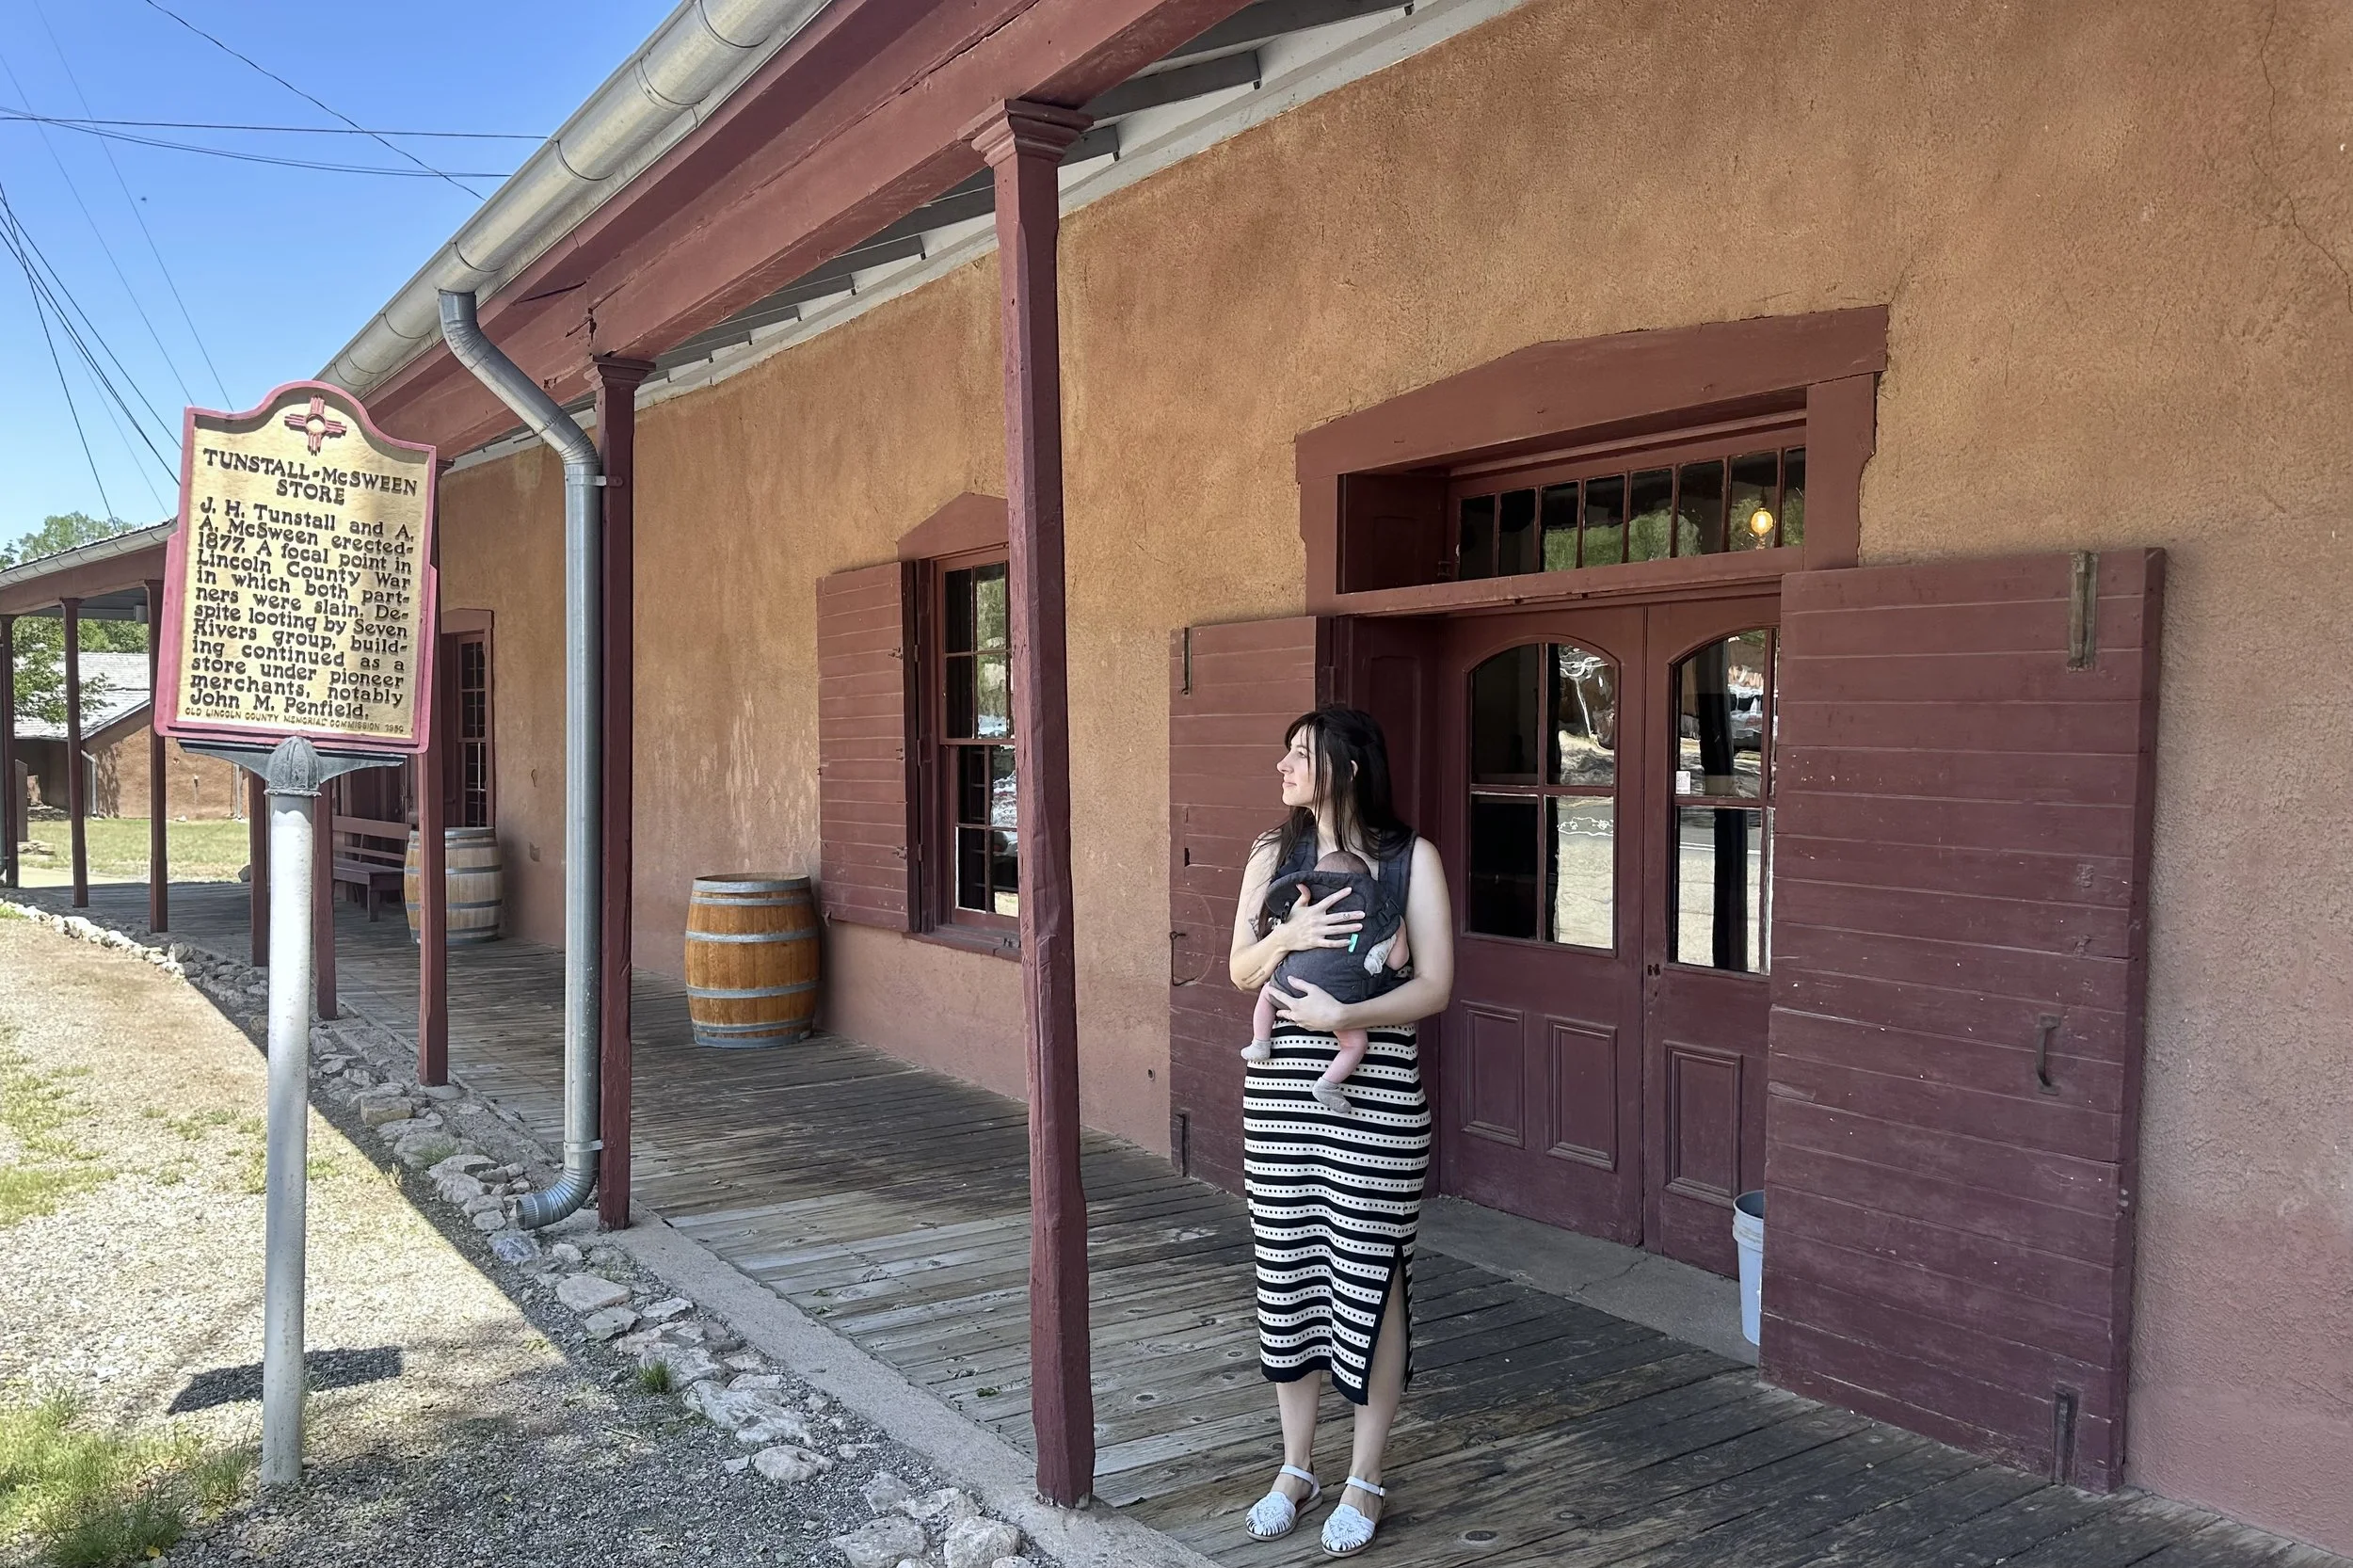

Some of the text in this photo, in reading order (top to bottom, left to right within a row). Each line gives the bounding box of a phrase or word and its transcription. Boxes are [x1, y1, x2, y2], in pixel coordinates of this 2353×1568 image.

[201, 447, 417, 496] TUNSTALL-McSWEEN
[276, 478, 345, 505] STORE
[198, 514, 413, 557] A. McSween erected-
[200, 496, 414, 543] J. H. Tunstall and A.
[197, 548, 411, 591] Lincoln County War
[198, 531, 411, 575] 1877. A focal point in
[196, 586, 408, 621] ners were slain. De-
[197, 565, 410, 606] in which both part-
[193, 617, 408, 656] Rivers group, build-
[194, 602, 408, 639] spite looting by Seven
[191, 655, 405, 690] store under pioneer
[192, 634, 405, 674] ing continued as a
[190, 674, 404, 709] merchants, notably
[190, 687, 369, 720] John M. Penfield.
[184, 707, 202, 717] OLD
[205, 708, 242, 720] LINCOLN
[245, 712, 280, 723] COUNTY
[329, 718, 380, 731] COMMISSION
